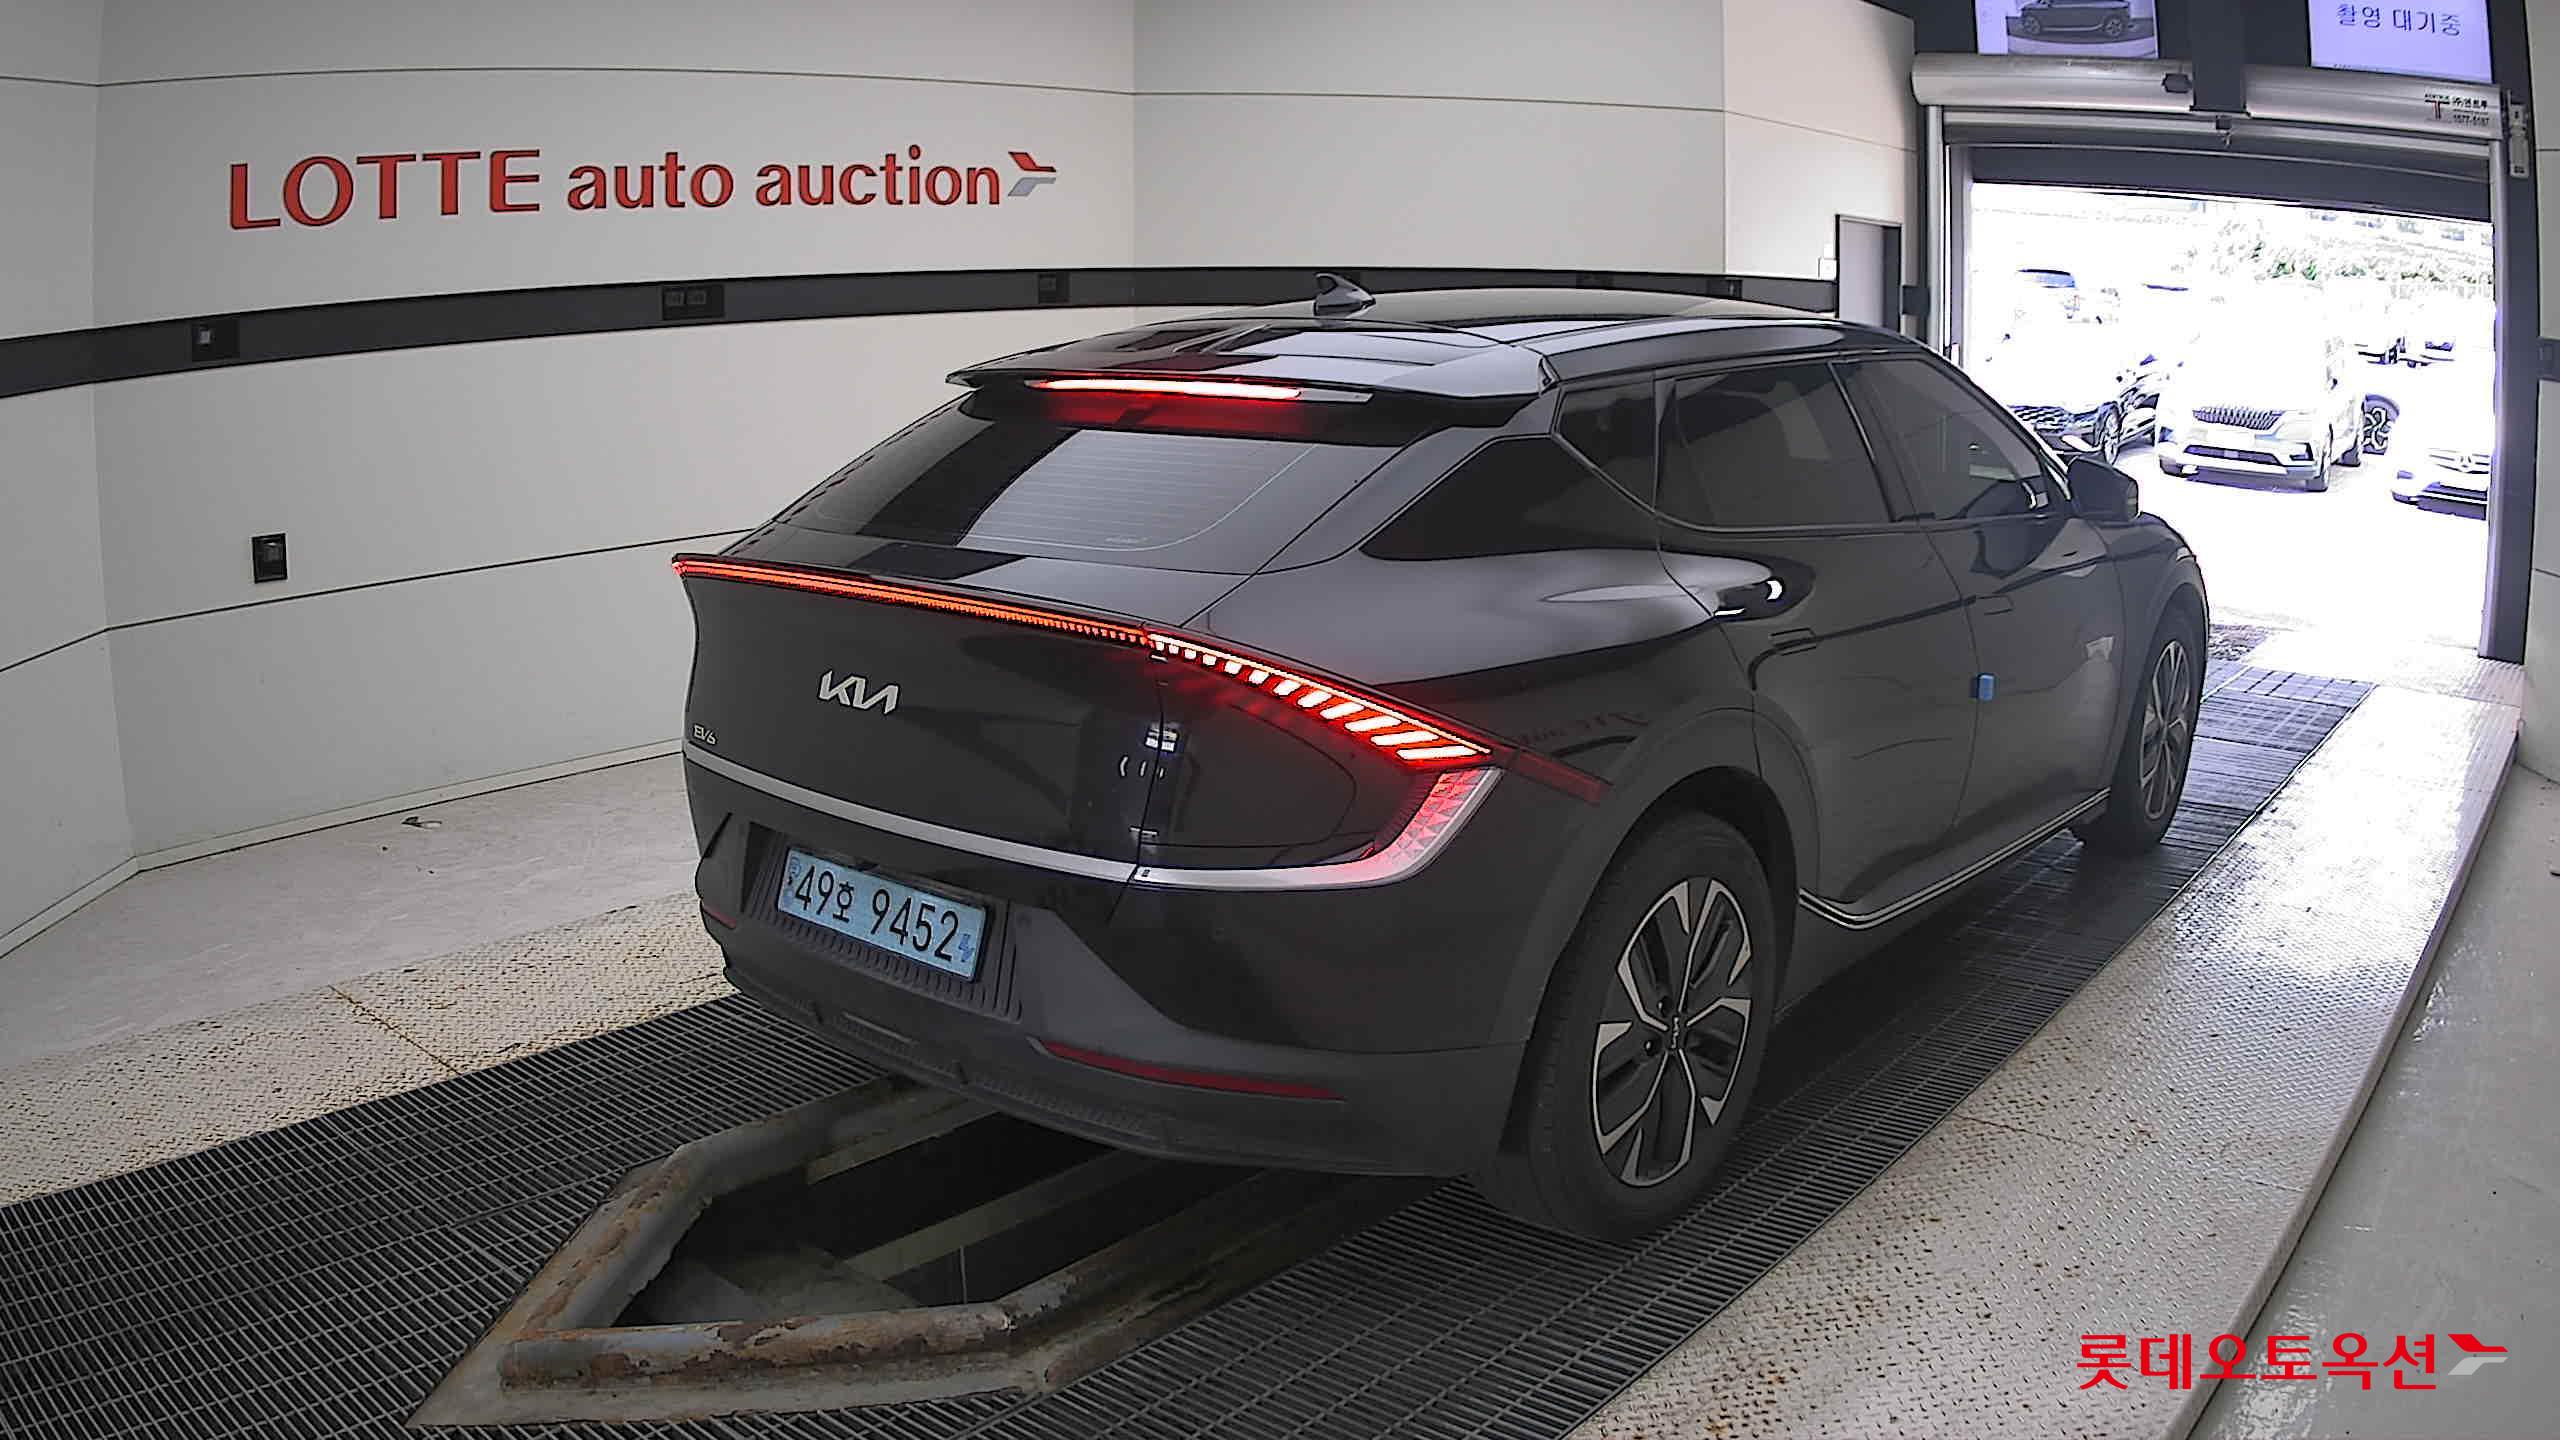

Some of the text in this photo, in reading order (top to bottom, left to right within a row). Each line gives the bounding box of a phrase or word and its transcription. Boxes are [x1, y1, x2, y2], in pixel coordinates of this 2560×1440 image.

[2392, 9, 2461, 36] 대기중
[230, 144, 1001, 230] LOTTE auto auction
[693, 724, 718, 745] EV6
[794, 864, 960, 962] 49호 9452
